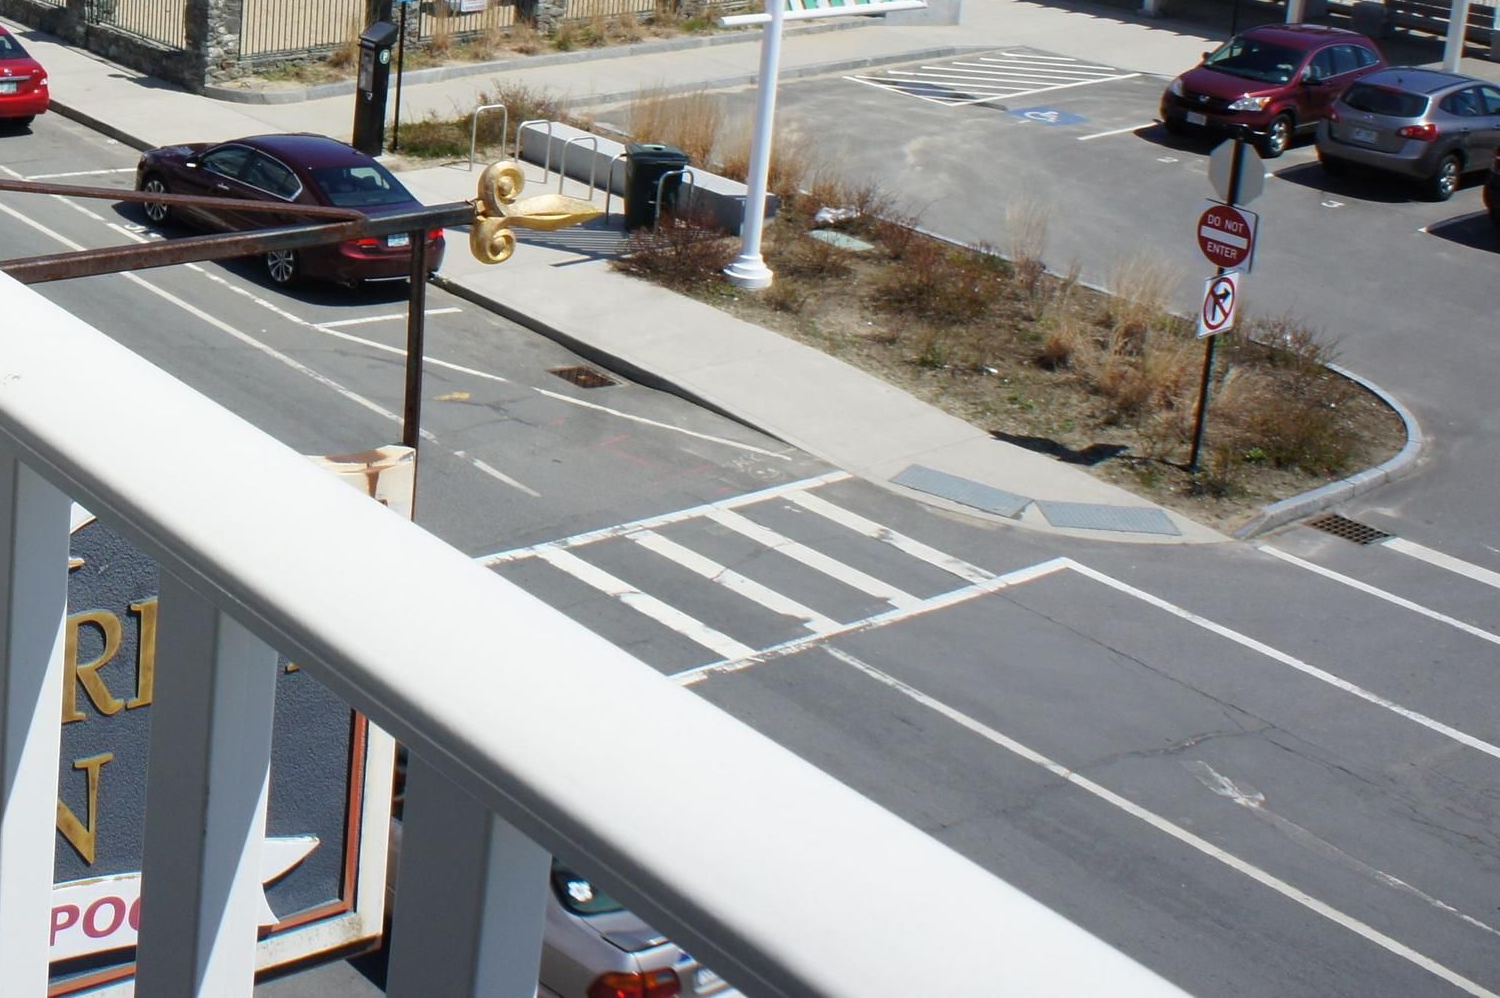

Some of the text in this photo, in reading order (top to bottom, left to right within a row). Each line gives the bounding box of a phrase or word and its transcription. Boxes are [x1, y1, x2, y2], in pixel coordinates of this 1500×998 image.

[1207, 214, 1244, 233] DO NOT
[1206, 242, 1237, 259] ENTER
